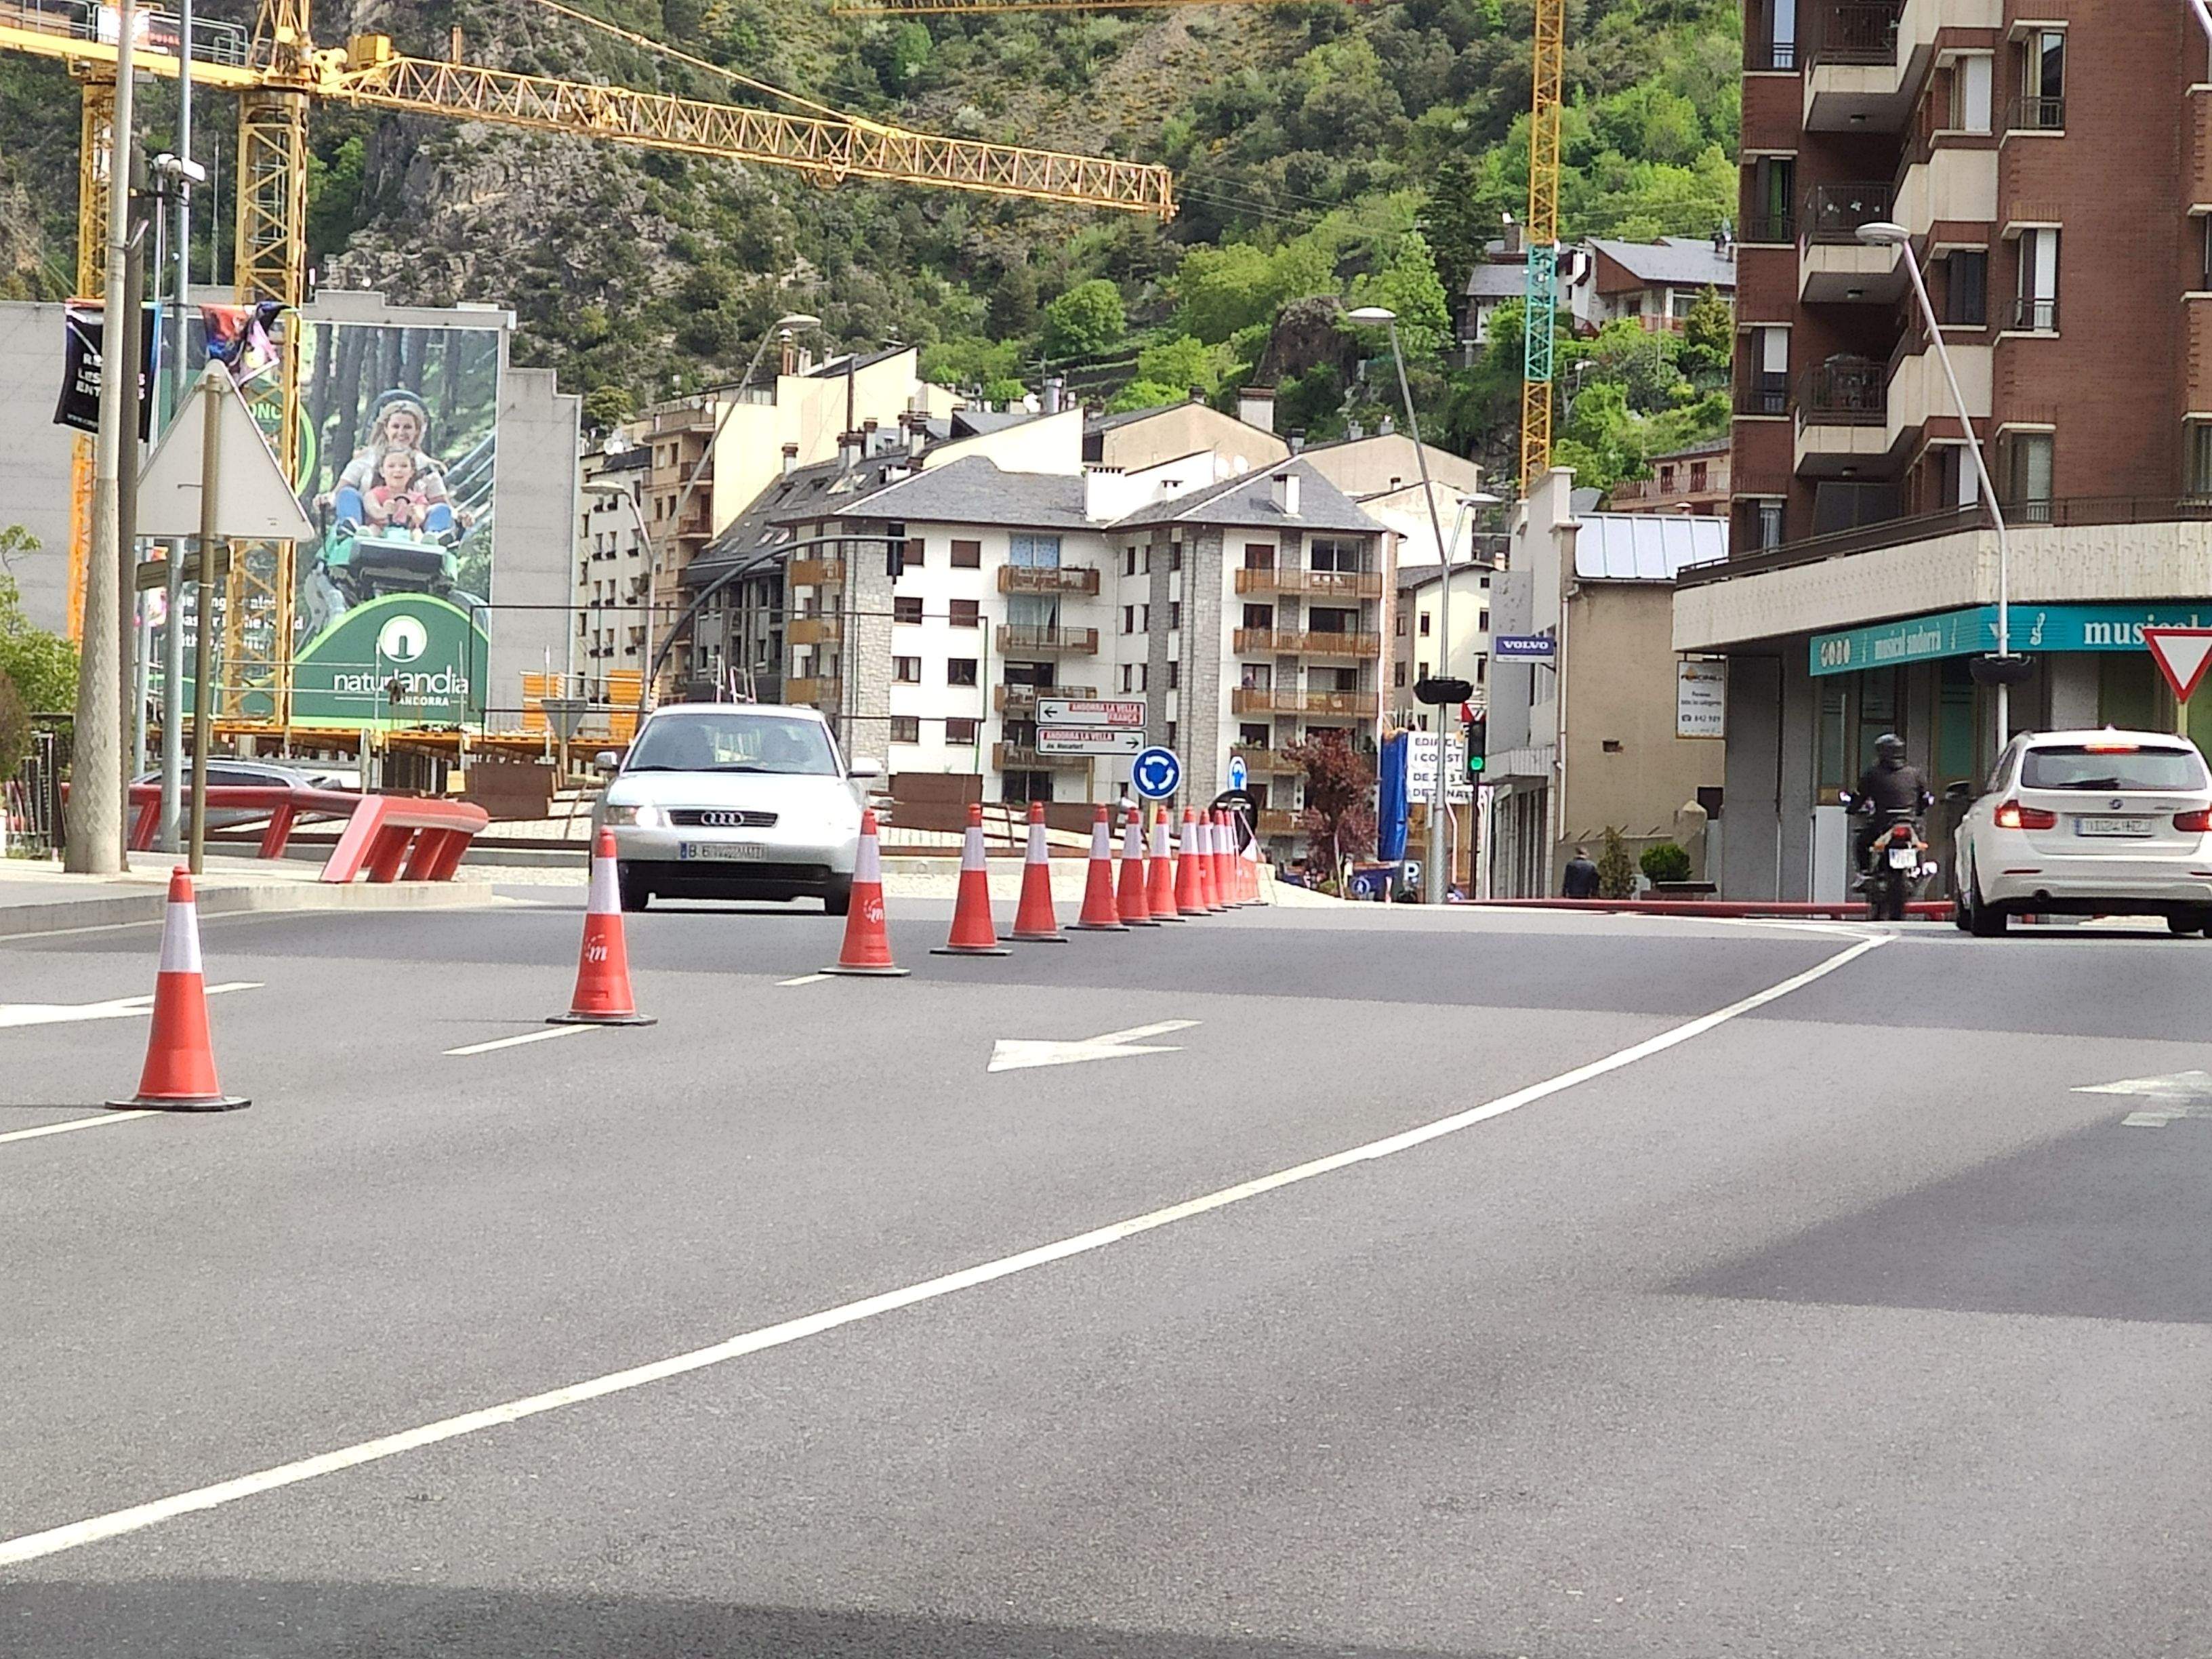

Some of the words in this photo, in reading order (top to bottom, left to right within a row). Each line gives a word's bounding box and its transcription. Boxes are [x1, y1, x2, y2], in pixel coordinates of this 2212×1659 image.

[1503, 640, 1549, 649] VOLVO
[1072, 703, 1105, 711] ANDORRA
[1106, 704, 1115, 712] LA
[1115, 704, 1138, 712] VELLA
[1047, 731, 1080, 740] ANDORRA
[1090, 733, 1113, 741] VELLA
[1404, 862, 1420, 881] P
